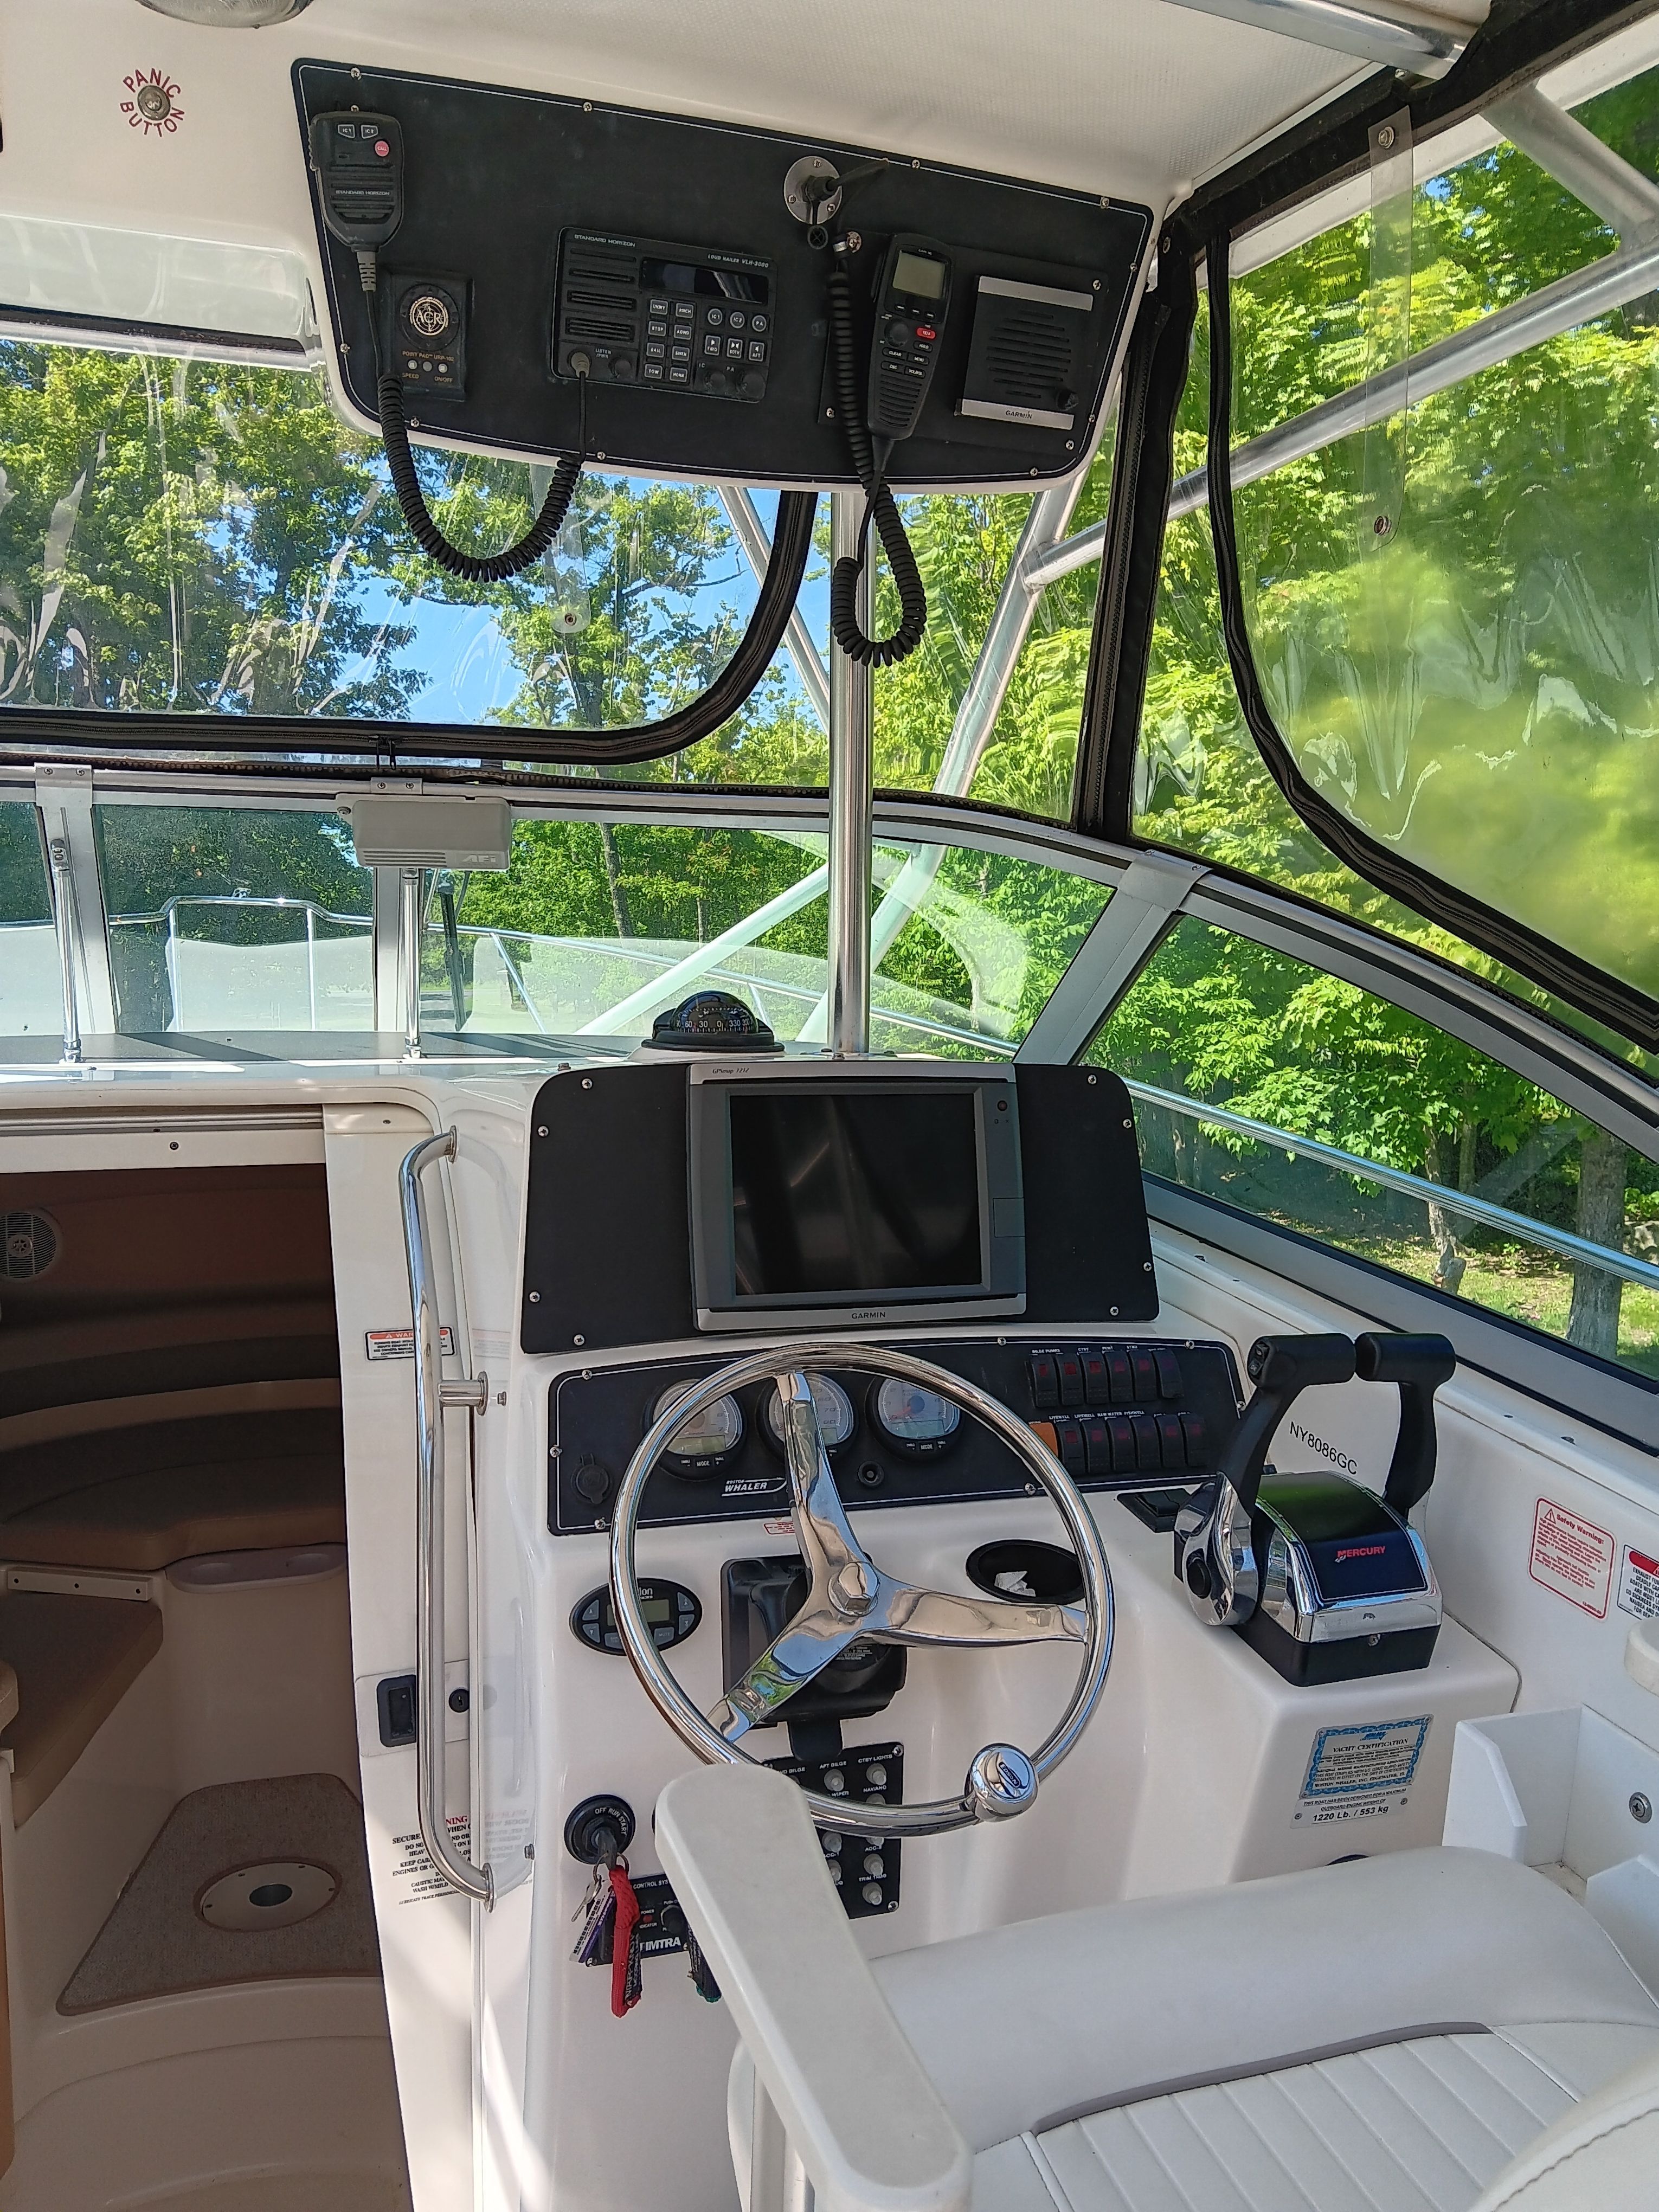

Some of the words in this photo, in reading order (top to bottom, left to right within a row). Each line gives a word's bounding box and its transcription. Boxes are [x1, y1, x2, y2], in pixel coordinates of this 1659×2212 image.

[123, 68, 181, 98] PANIC
[120, 102, 185, 137] BUTTON
[574, 234, 606, 242] STANDARD
[608, 239, 635, 247] HORIZON
[416, 309, 444, 325] ACR
[1005, 410, 1033, 419] GARMIN
[1290, 1421, 1357, 1475] NY8086GC
[725, 1482, 767, 1492] WHALER
[1557, 1514, 1576, 1529] Safety
[1577, 1525, 1604, 1545] Warning:
[1337, 1546, 1386, 1558] MERCURY
[1632, 1567, 1651, 1580] EXHAUST
[1630, 1578, 1642, 1589] BOATS
[1643, 1586, 1654, 1595] WITH
[1636, 1575, 1651, 1587] DEADLY
[1632, 1592, 1651, 1606] SICKNESS
[1634, 1587, 1642, 1595] ARE
[1643, 1592, 1655, 1602] MOST
[1629, 1597, 1645, 1610] NAUSEA
[1646, 1606, 1654, 1615] AND
[1634, 1606, 1642, 1615] FOR
[1357, 1739, 1408, 1750] CERTIFICATION
[1313, 1812, 1334, 1822] 1220
[1360, 1807, 1375, 1816] 553
[608, 1808, 621, 1818] RUN
[618, 1816, 627, 1836] START
[392, 1833, 421, 1844] SECURE
[409, 1849, 426, 1857] HEAV
[392, 1865, 419, 1876] ENGINES
[400, 1860, 416, 1868] KEEP
[633, 1881, 658, 1889] CONTROL
[645, 1937, 681, 1951] IMTRA
